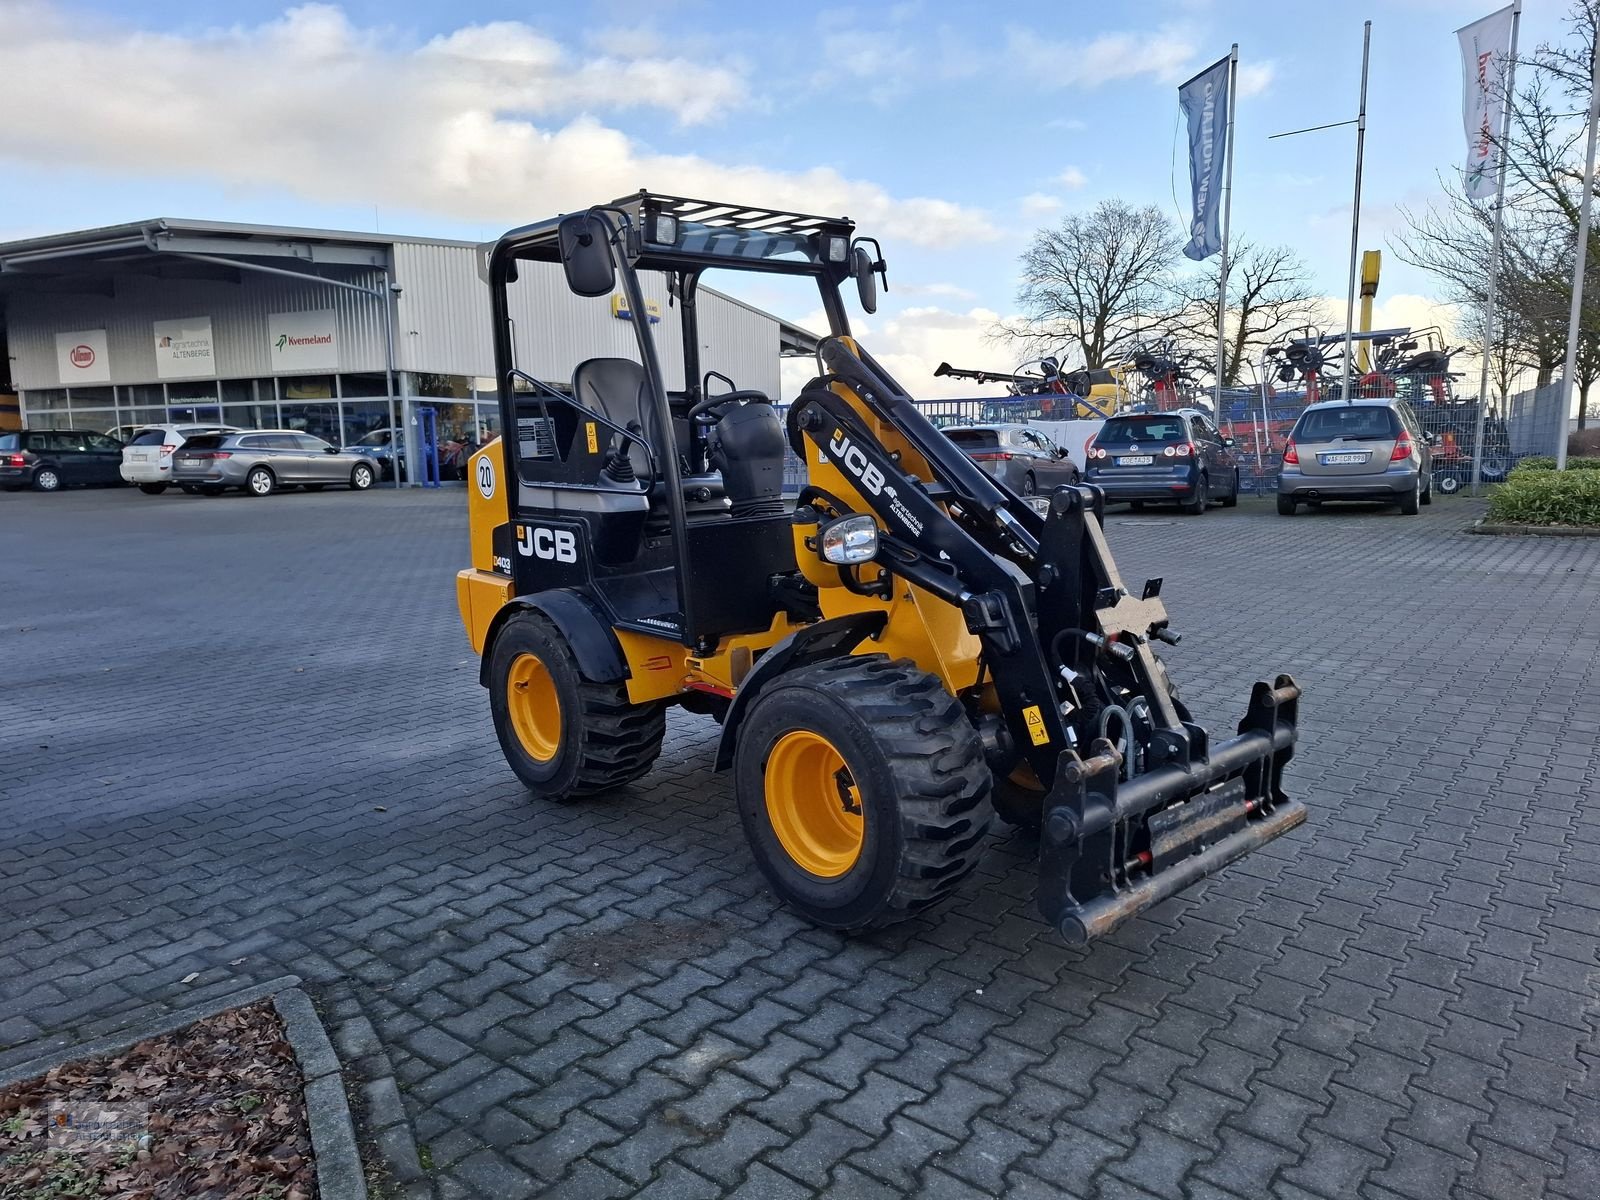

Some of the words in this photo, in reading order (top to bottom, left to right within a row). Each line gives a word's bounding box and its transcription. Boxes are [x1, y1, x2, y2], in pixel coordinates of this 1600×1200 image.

[173, 349, 211, 358] ALTENBERGE
[288, 333, 332, 346] Kverneland
[480, 466, 491, 488] 20
[829, 437, 885, 496] JCB
[889, 503, 921, 538] ALTENBERGE
[893, 497, 924, 532] agrartechnik
[517, 526, 577, 564] JCB
